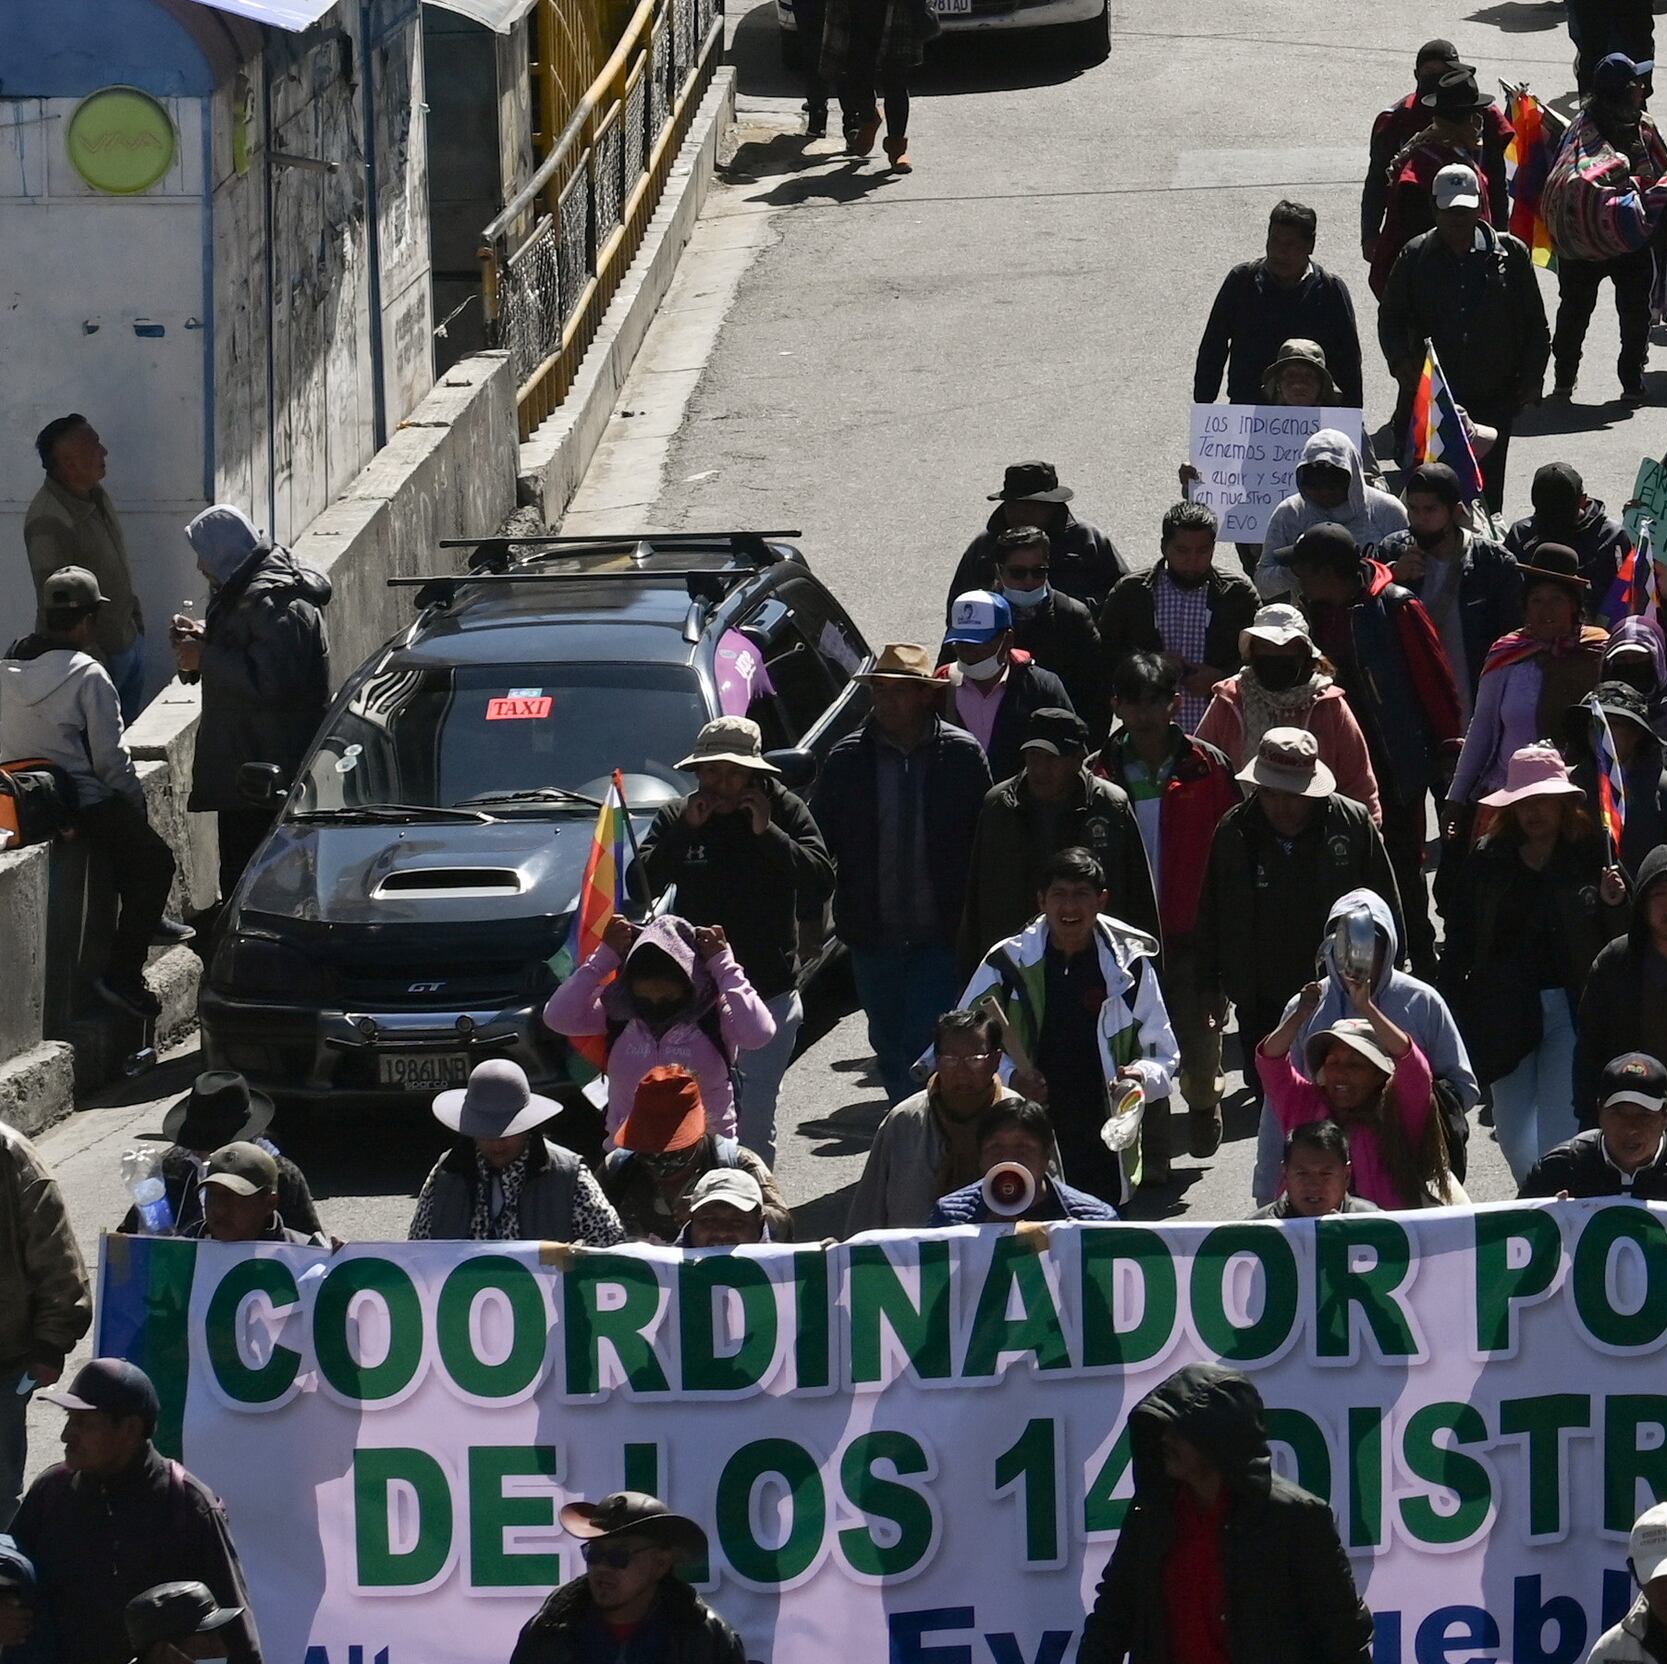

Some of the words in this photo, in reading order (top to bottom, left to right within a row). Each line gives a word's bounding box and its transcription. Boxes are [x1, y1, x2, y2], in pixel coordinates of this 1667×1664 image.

[1204, 415, 1229, 436] LOS
[1226, 513, 1258, 531] EVO
[494, 700, 546, 716] TAXI
[407, 981, 448, 993] GT
[404, 1079, 449, 1091] sparco
[204, 1219, 1416, 1404] COORDINADOR
[352, 1441, 560, 1589] DE
[622, 1429, 938, 1585] LOS
